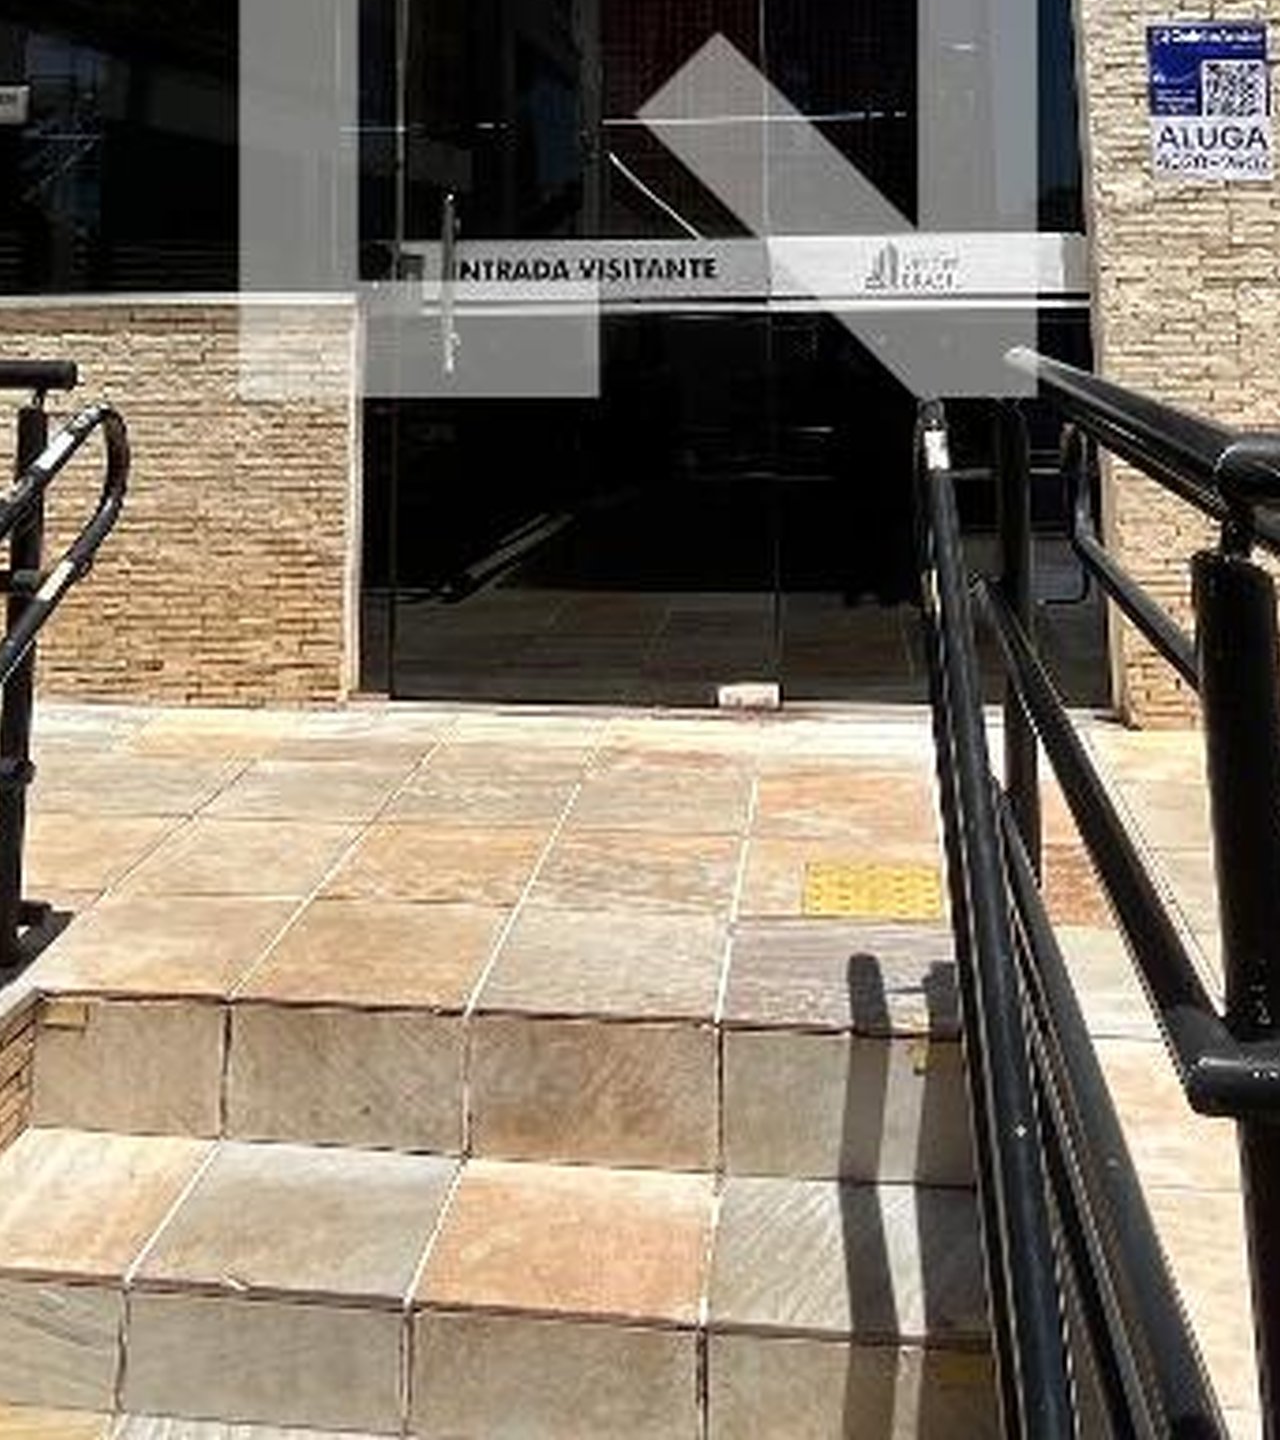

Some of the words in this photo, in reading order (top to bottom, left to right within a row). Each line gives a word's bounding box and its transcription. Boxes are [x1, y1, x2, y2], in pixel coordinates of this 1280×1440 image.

[1156, 125, 1269, 151] ALUGA
[451, 258, 571, 282] NTRADA
[578, 257, 718, 281] VISITANTE
